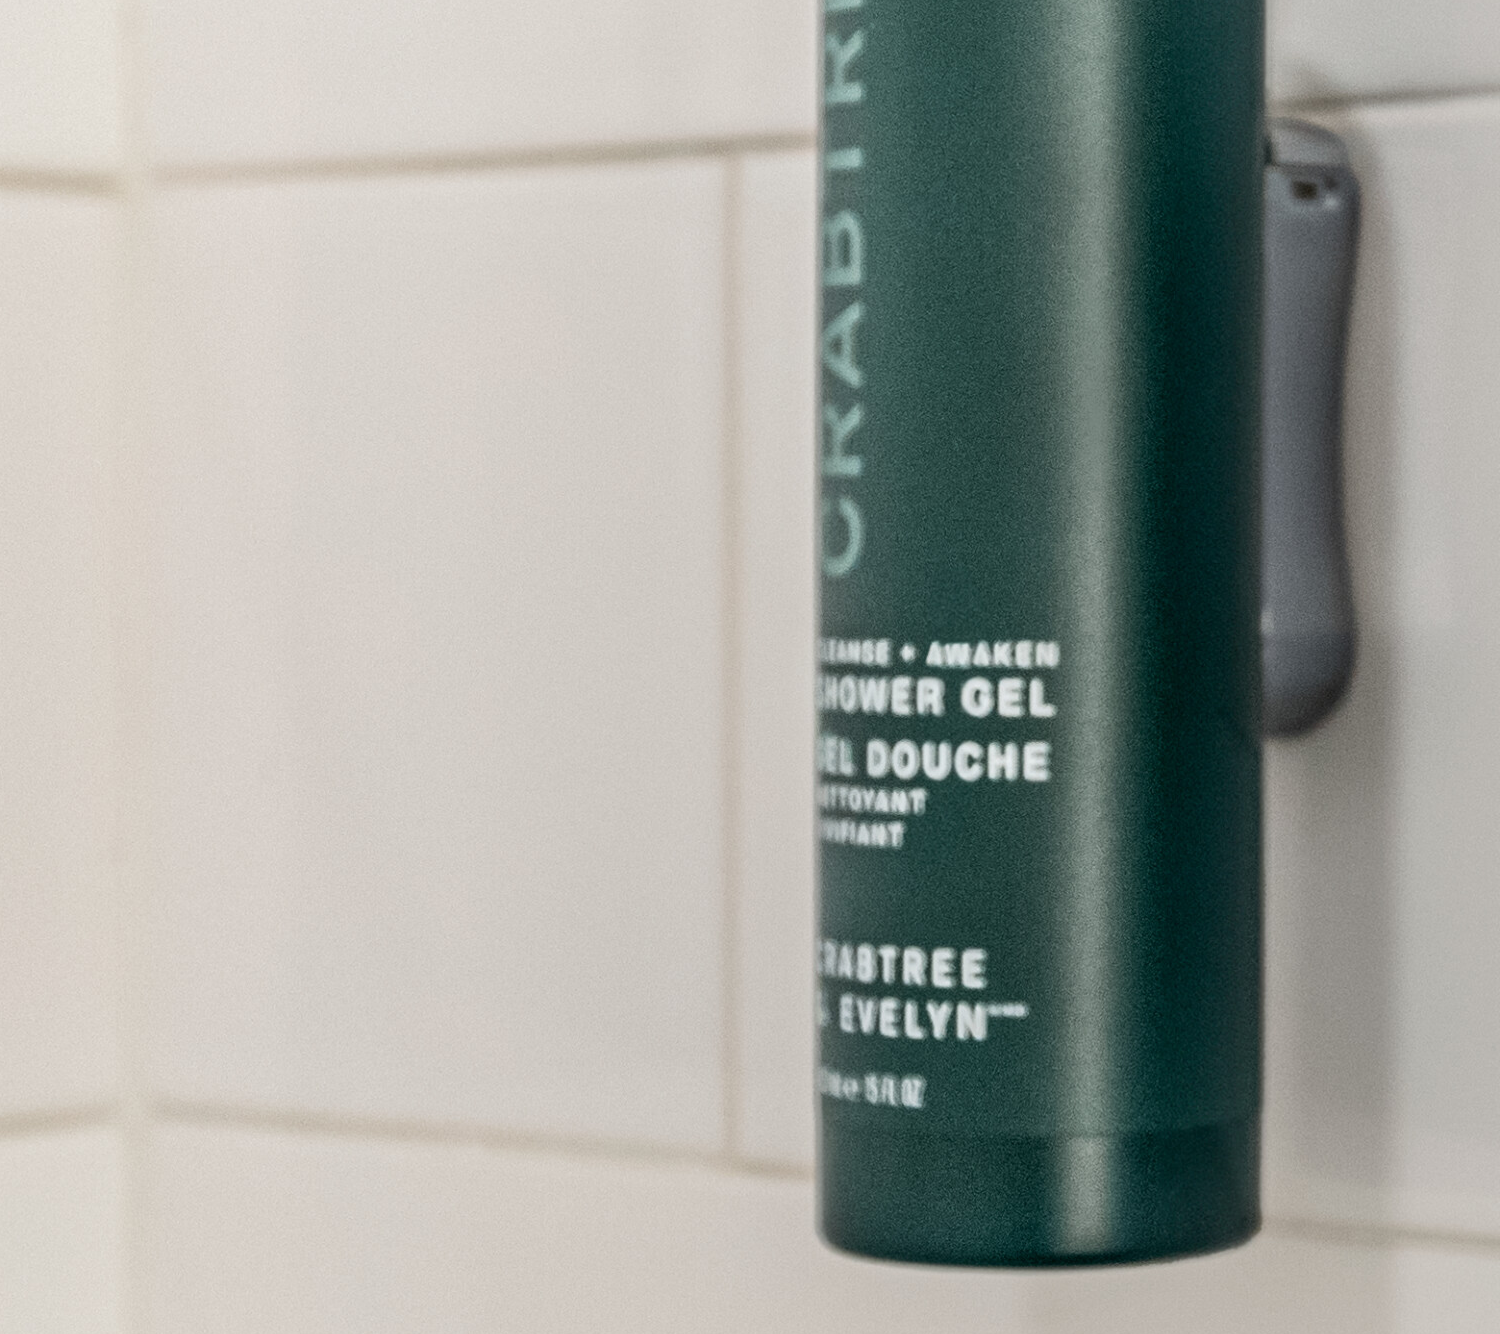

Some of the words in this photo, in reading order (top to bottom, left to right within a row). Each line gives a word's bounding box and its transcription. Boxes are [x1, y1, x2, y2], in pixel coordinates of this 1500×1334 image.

[925, 641, 1060, 668] AWAKEN
[960, 676, 1057, 717] GEL
[866, 739, 1051, 782] DOUCHE
[839, 994, 989, 1041] EVELYN
